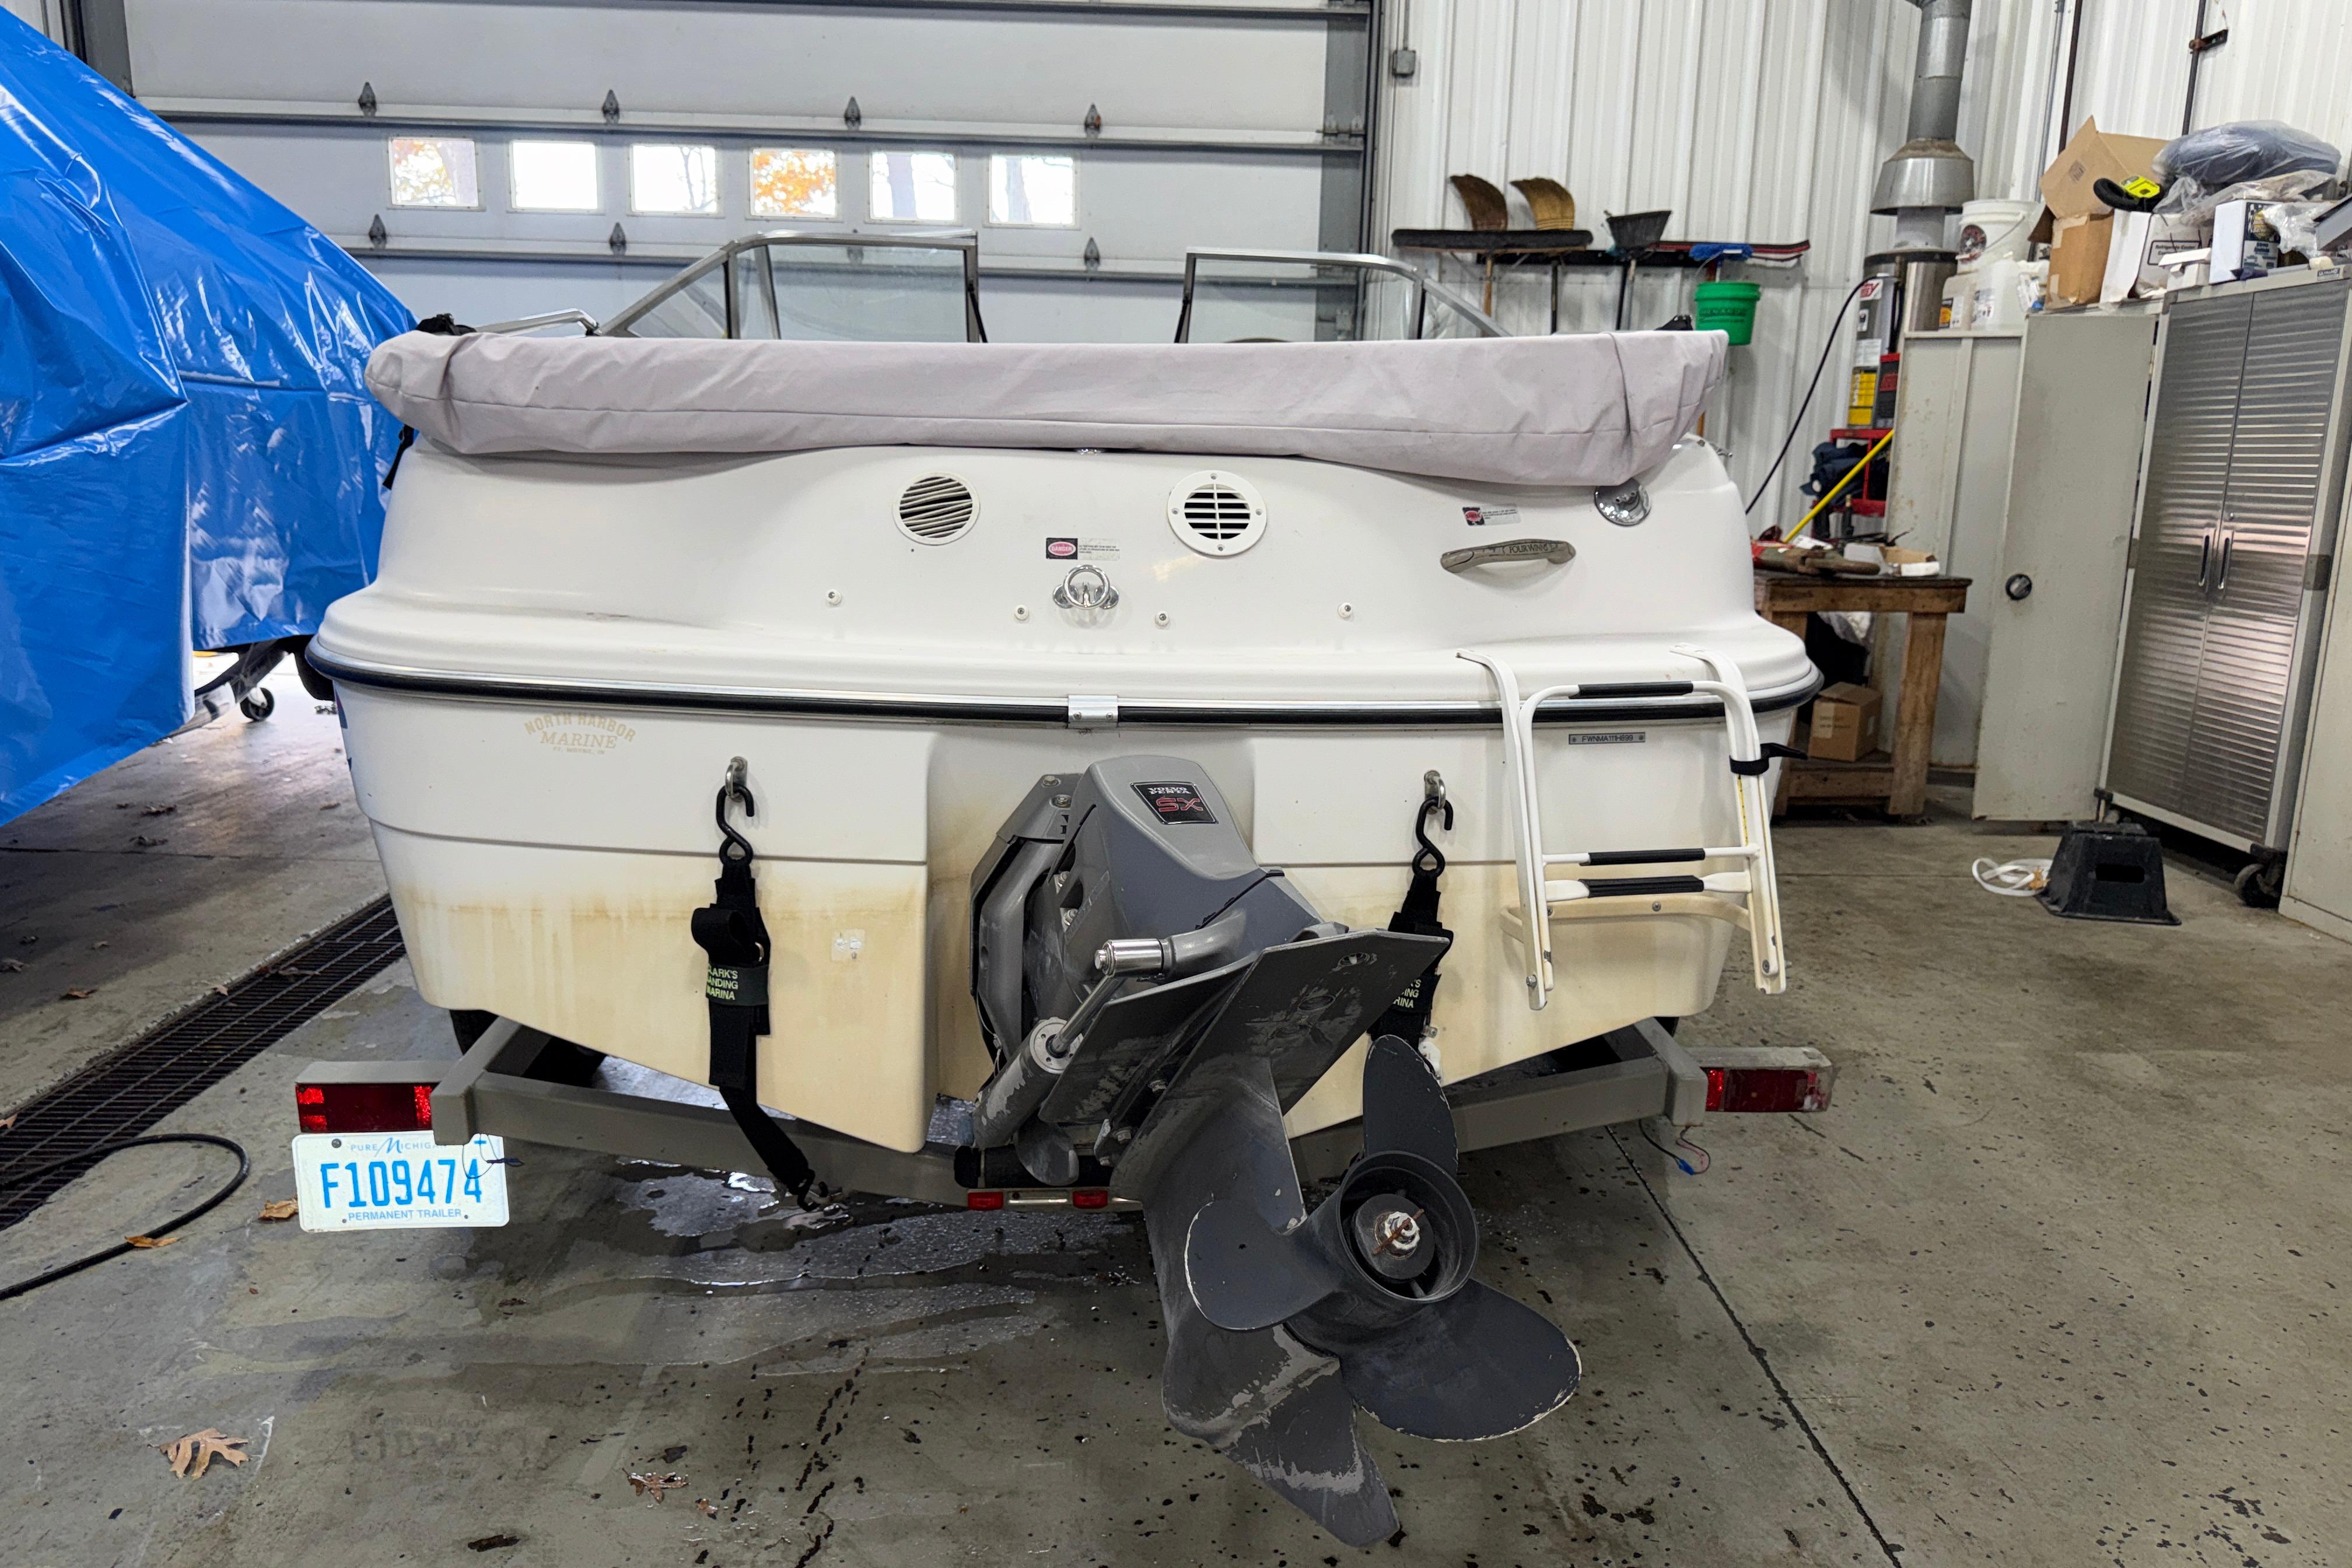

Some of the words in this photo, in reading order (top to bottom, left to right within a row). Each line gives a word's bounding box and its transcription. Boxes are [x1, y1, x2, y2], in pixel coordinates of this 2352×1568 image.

[524, 712, 572, 734] NORTH
[578, 713, 636, 742] HARBOR
[540, 731, 617, 748] MARINE
[1156, 798, 1203, 812] SX
[708, 975, 738, 990] ANDING
[1393, 996, 1414, 1008] RINA
[320, 1158, 482, 1209] F109474
[348, 1210, 414, 1221] PERMANENT
[418, 1209, 461, 1219] TRAILER
